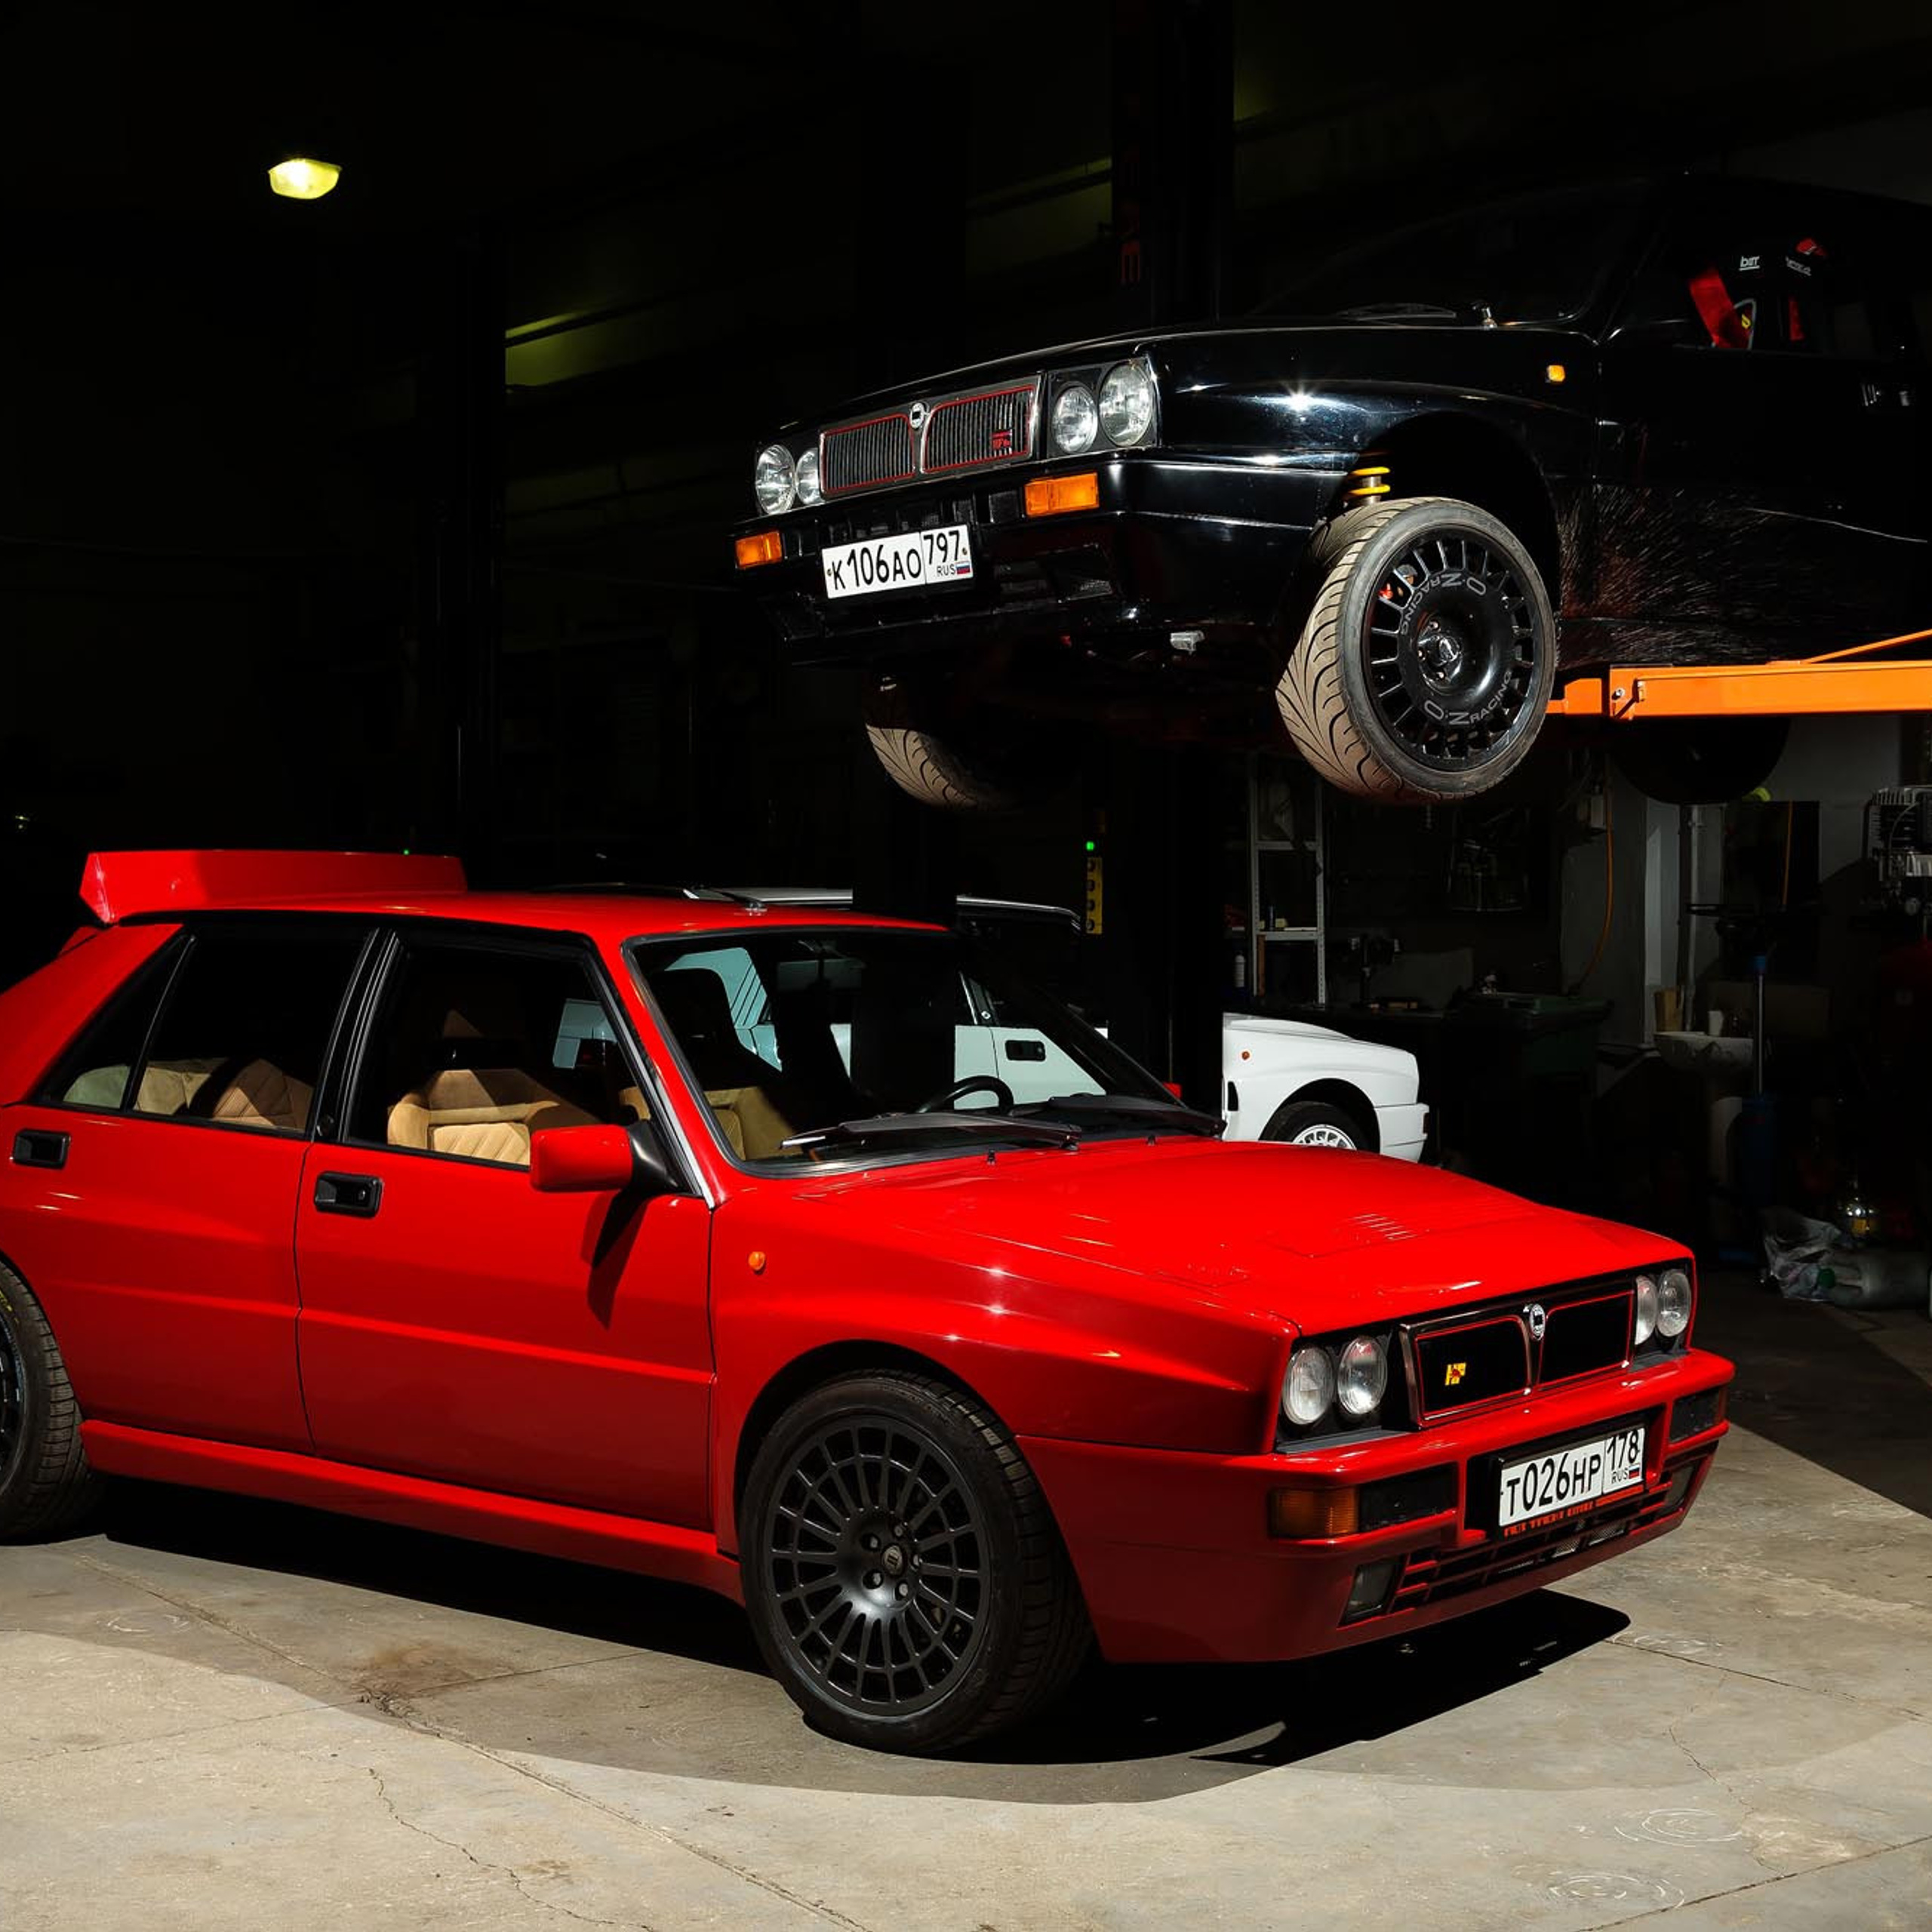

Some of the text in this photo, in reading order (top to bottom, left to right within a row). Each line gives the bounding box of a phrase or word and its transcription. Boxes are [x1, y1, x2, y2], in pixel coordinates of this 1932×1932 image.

[832, 530, 960, 590] K106AO 797
[937, 564, 956, 577] RUS
[1400, 576, 1441, 635] RACING
[1469, 669, 1512, 724] RACING
[1506, 1429, 1640, 1517] T026HP 178
[1611, 1467, 1629, 1484] RUS
